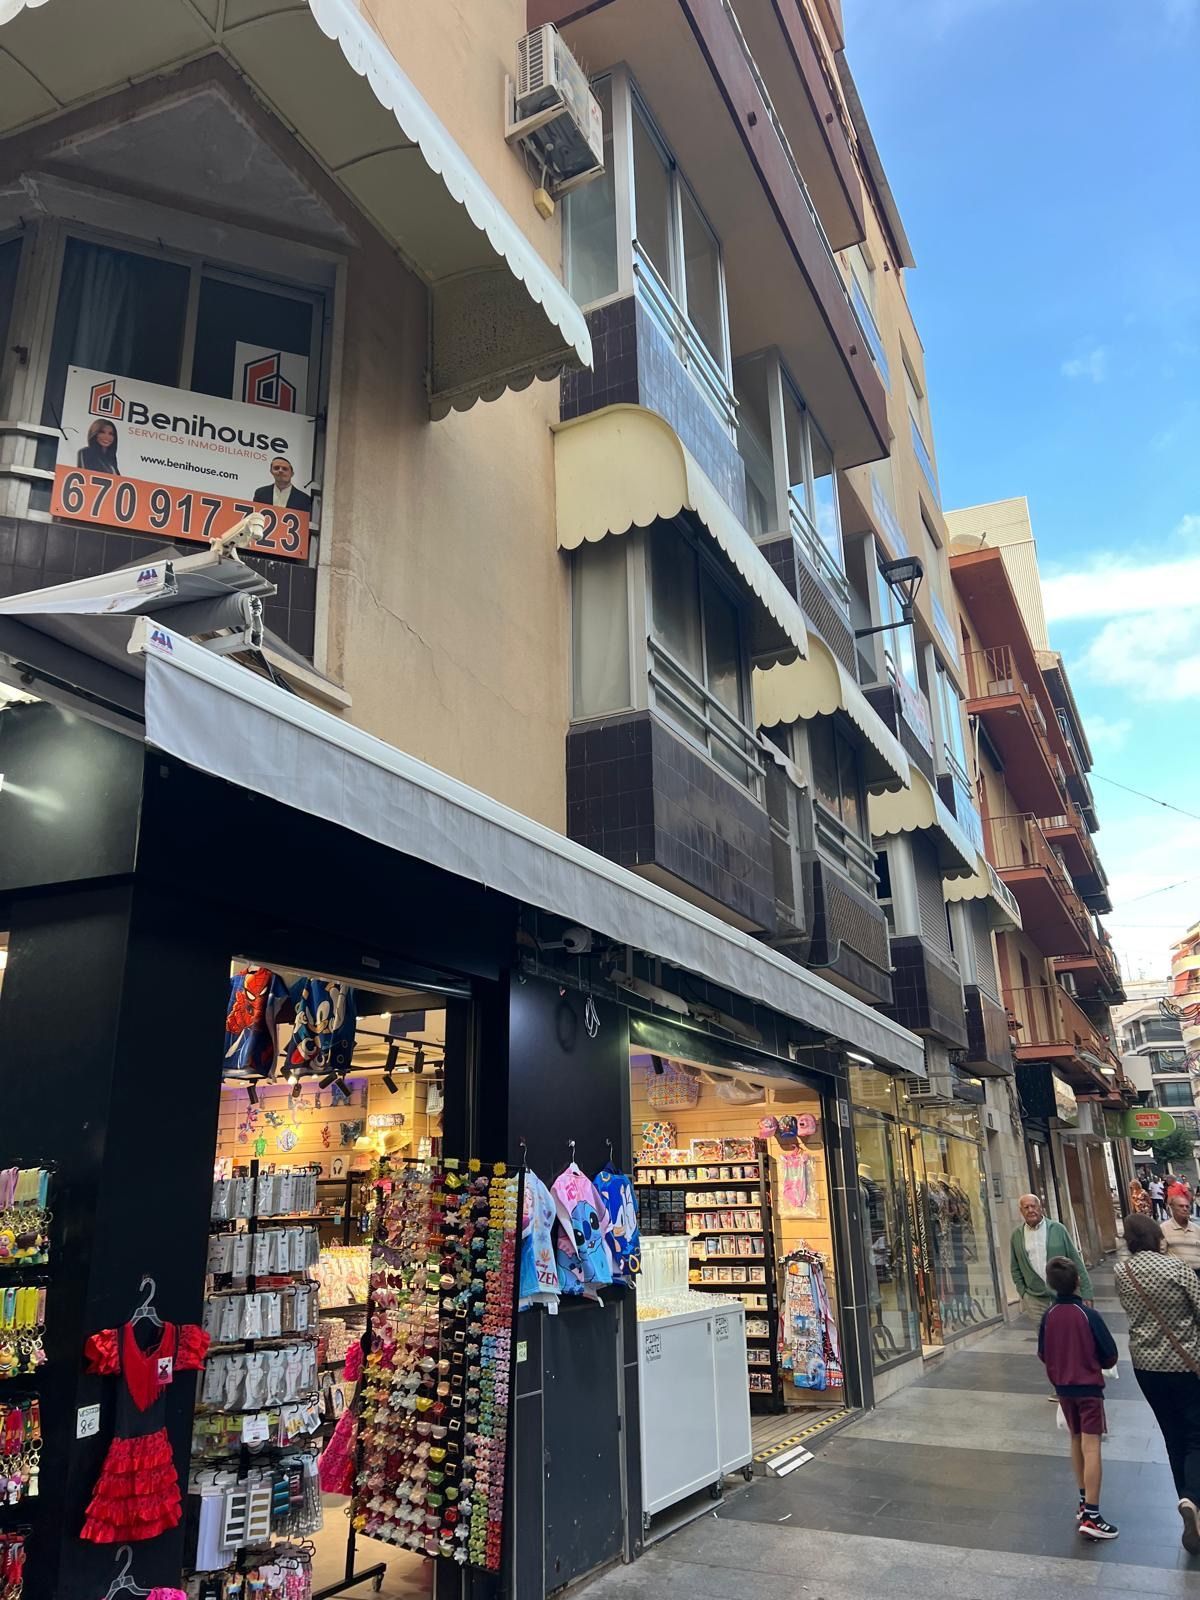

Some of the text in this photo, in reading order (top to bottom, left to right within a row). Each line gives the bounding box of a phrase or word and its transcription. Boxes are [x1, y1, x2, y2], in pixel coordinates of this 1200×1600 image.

[127, 400, 289, 454] Benihouse
[128, 426, 268, 462] SERVICIOS INMOBILIARIOS
[140, 455, 239, 481] www.benihouse.com
[62, 472, 137, 523] 670
[149, 488, 222, 537] 917
